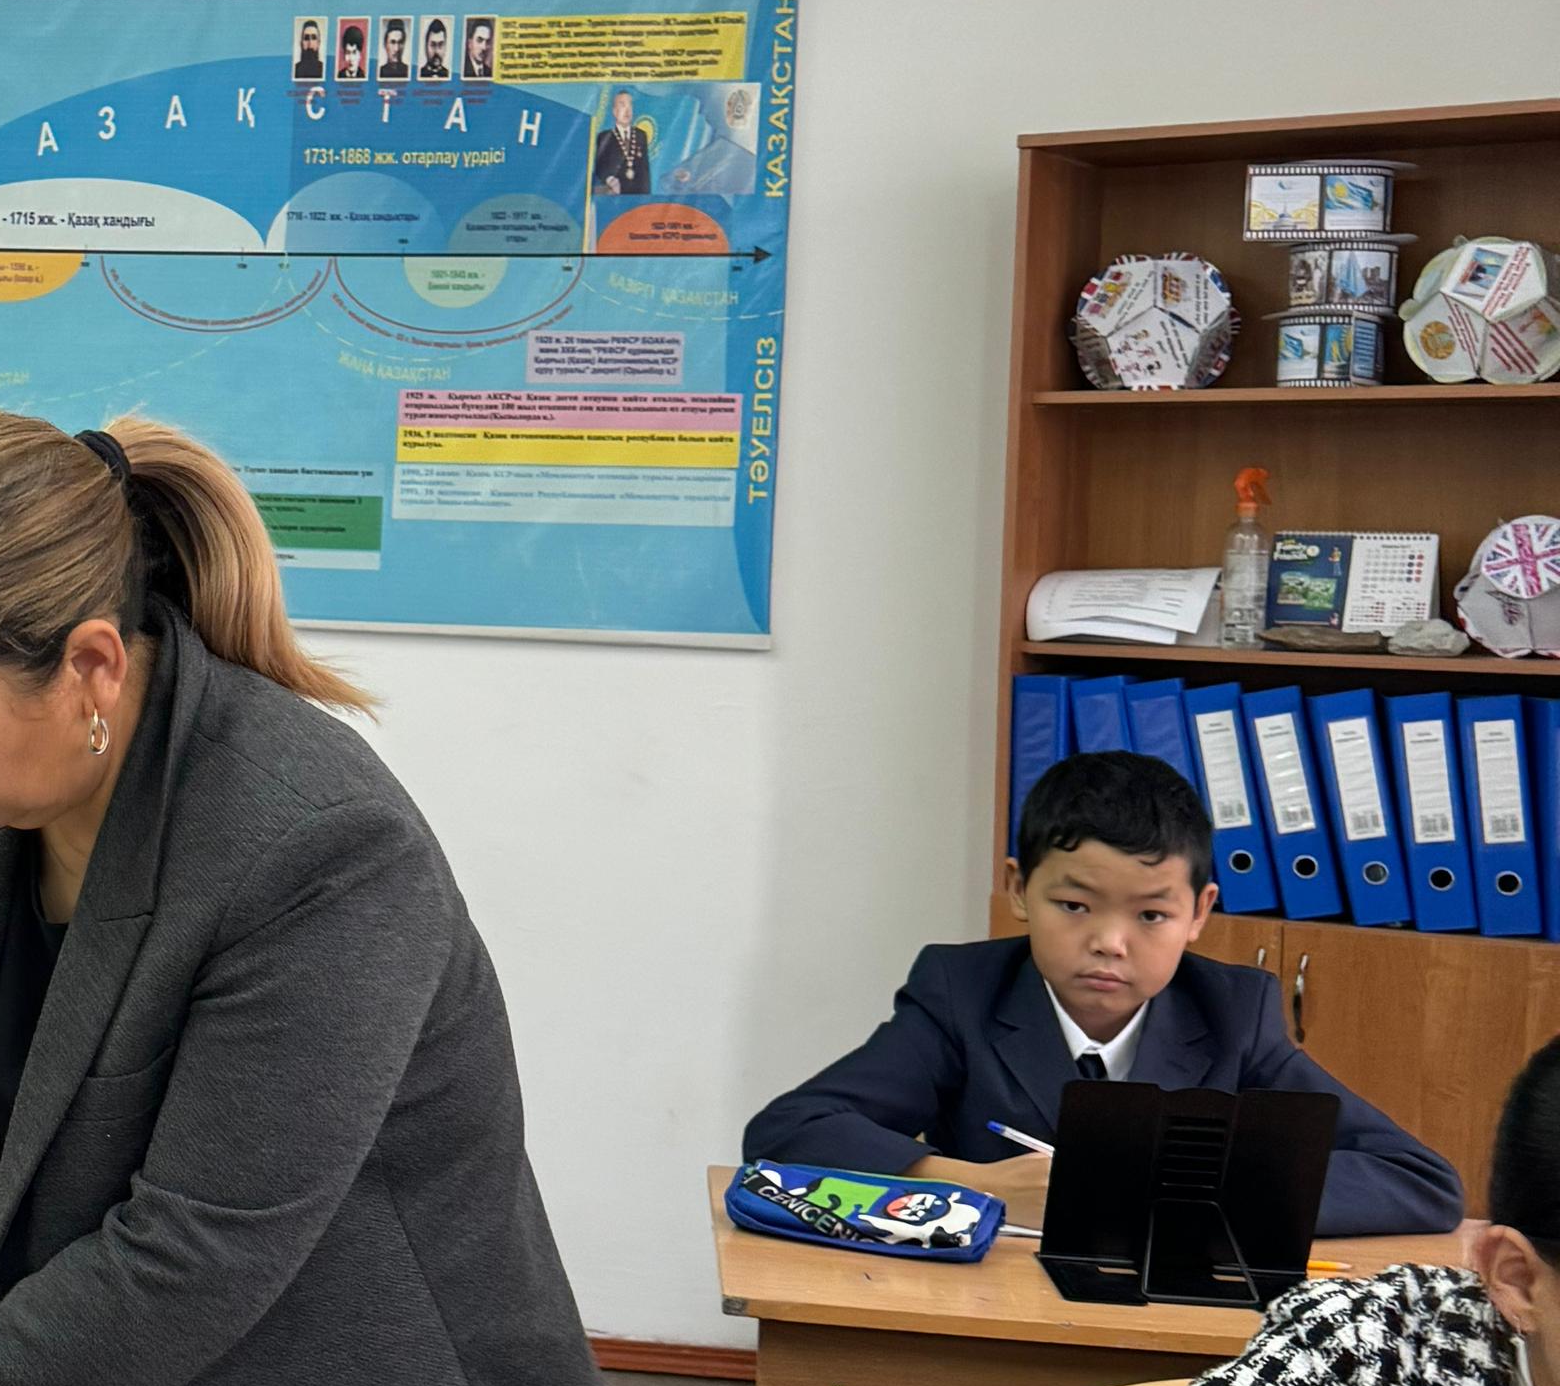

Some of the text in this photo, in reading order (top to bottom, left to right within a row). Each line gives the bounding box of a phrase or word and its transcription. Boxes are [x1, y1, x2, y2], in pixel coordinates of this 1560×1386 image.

[304, 148, 371, 164] 1731-1868
[402, 152, 459, 168] отарлау
[462, 148, 506, 168] үрдісі
[10, 212, 35, 226] 1715
[67, 213, 101, 228] Қазақ
[103, 215, 155, 228] хандығы
[748, 336, 777, 505] ТӘУЕЛСІЗ
